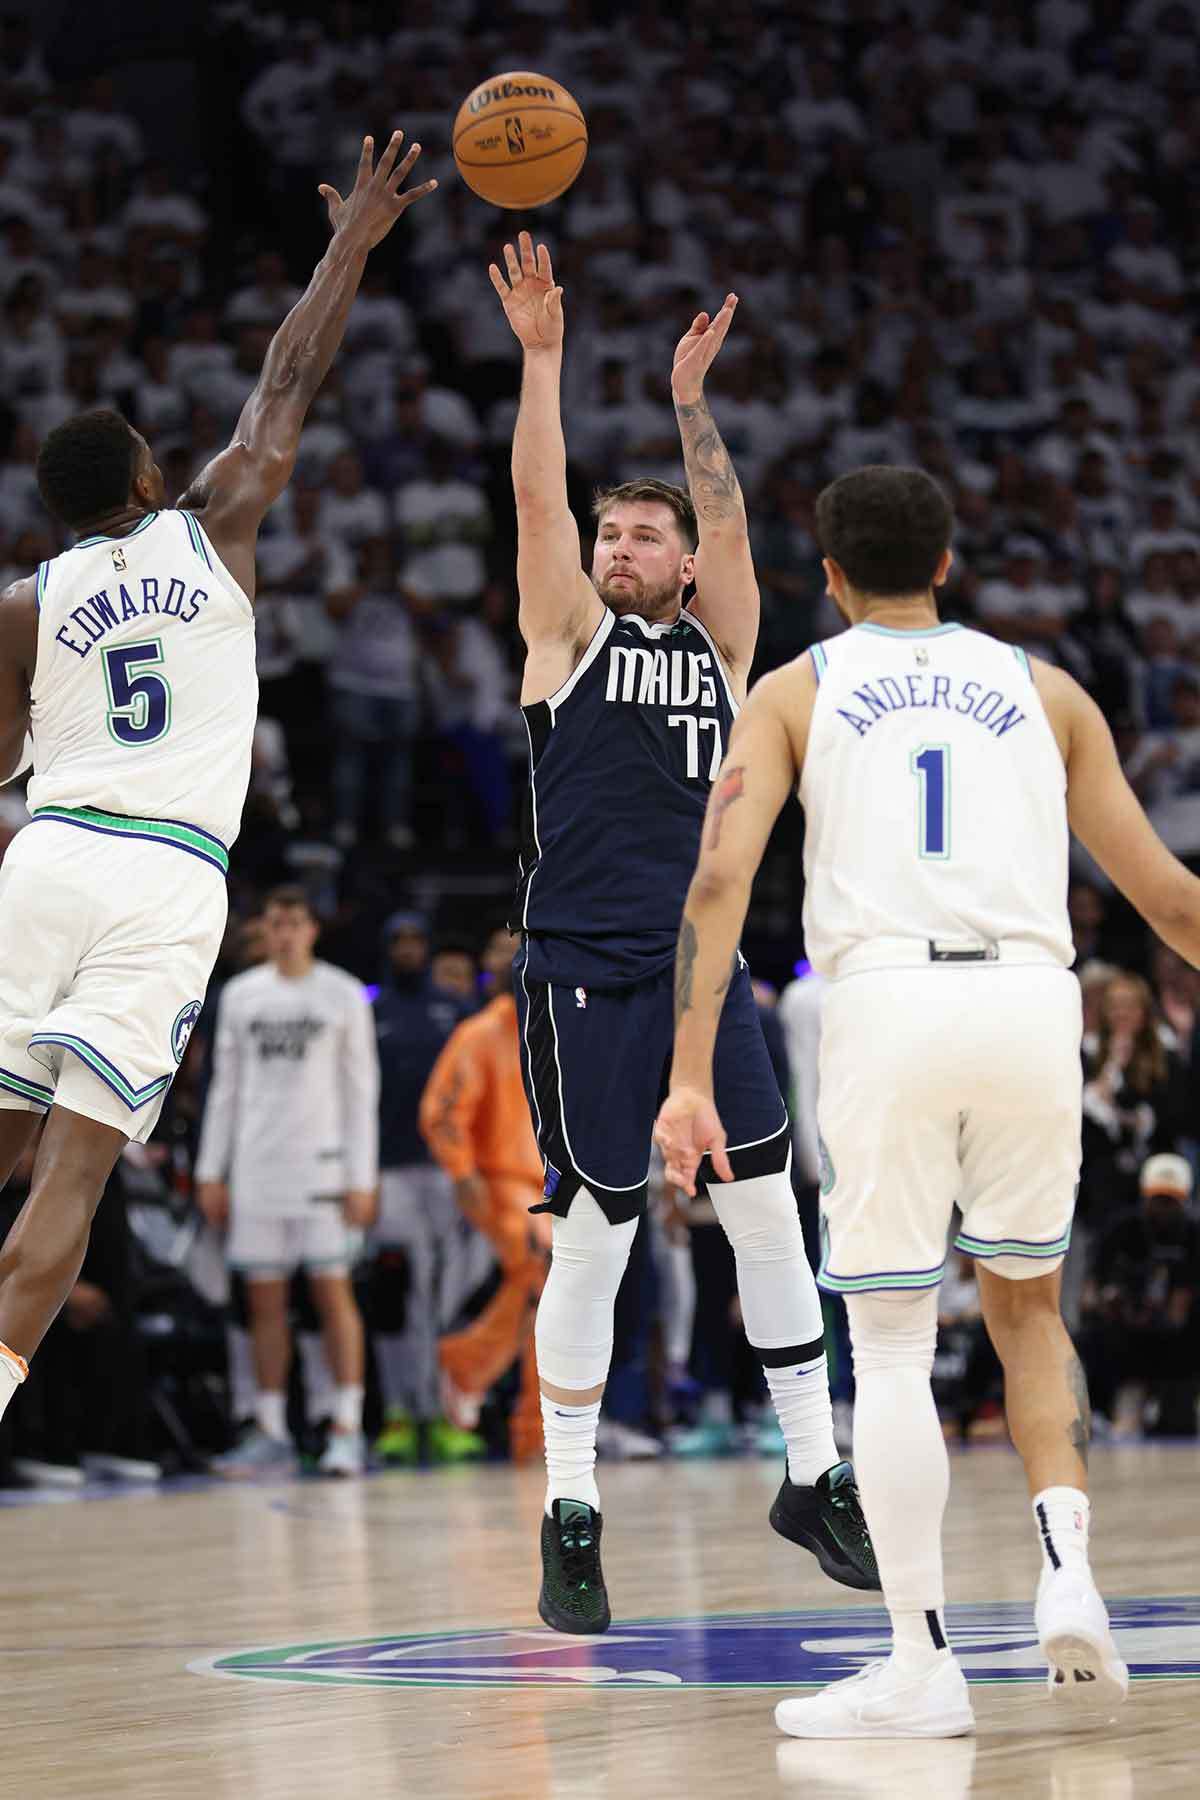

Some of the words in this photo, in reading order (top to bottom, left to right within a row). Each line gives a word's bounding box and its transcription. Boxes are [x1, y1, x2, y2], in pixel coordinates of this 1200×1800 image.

[469, 81, 555, 113] Wilson
[55, 578, 208, 658] EDWARDS
[100, 637, 172, 748] 5
[605, 646, 717, 707] MAVS
[837, 675, 1025, 737] ANDERSON
[667, 714, 723, 782] 77
[909, 741, 951, 861] 1
